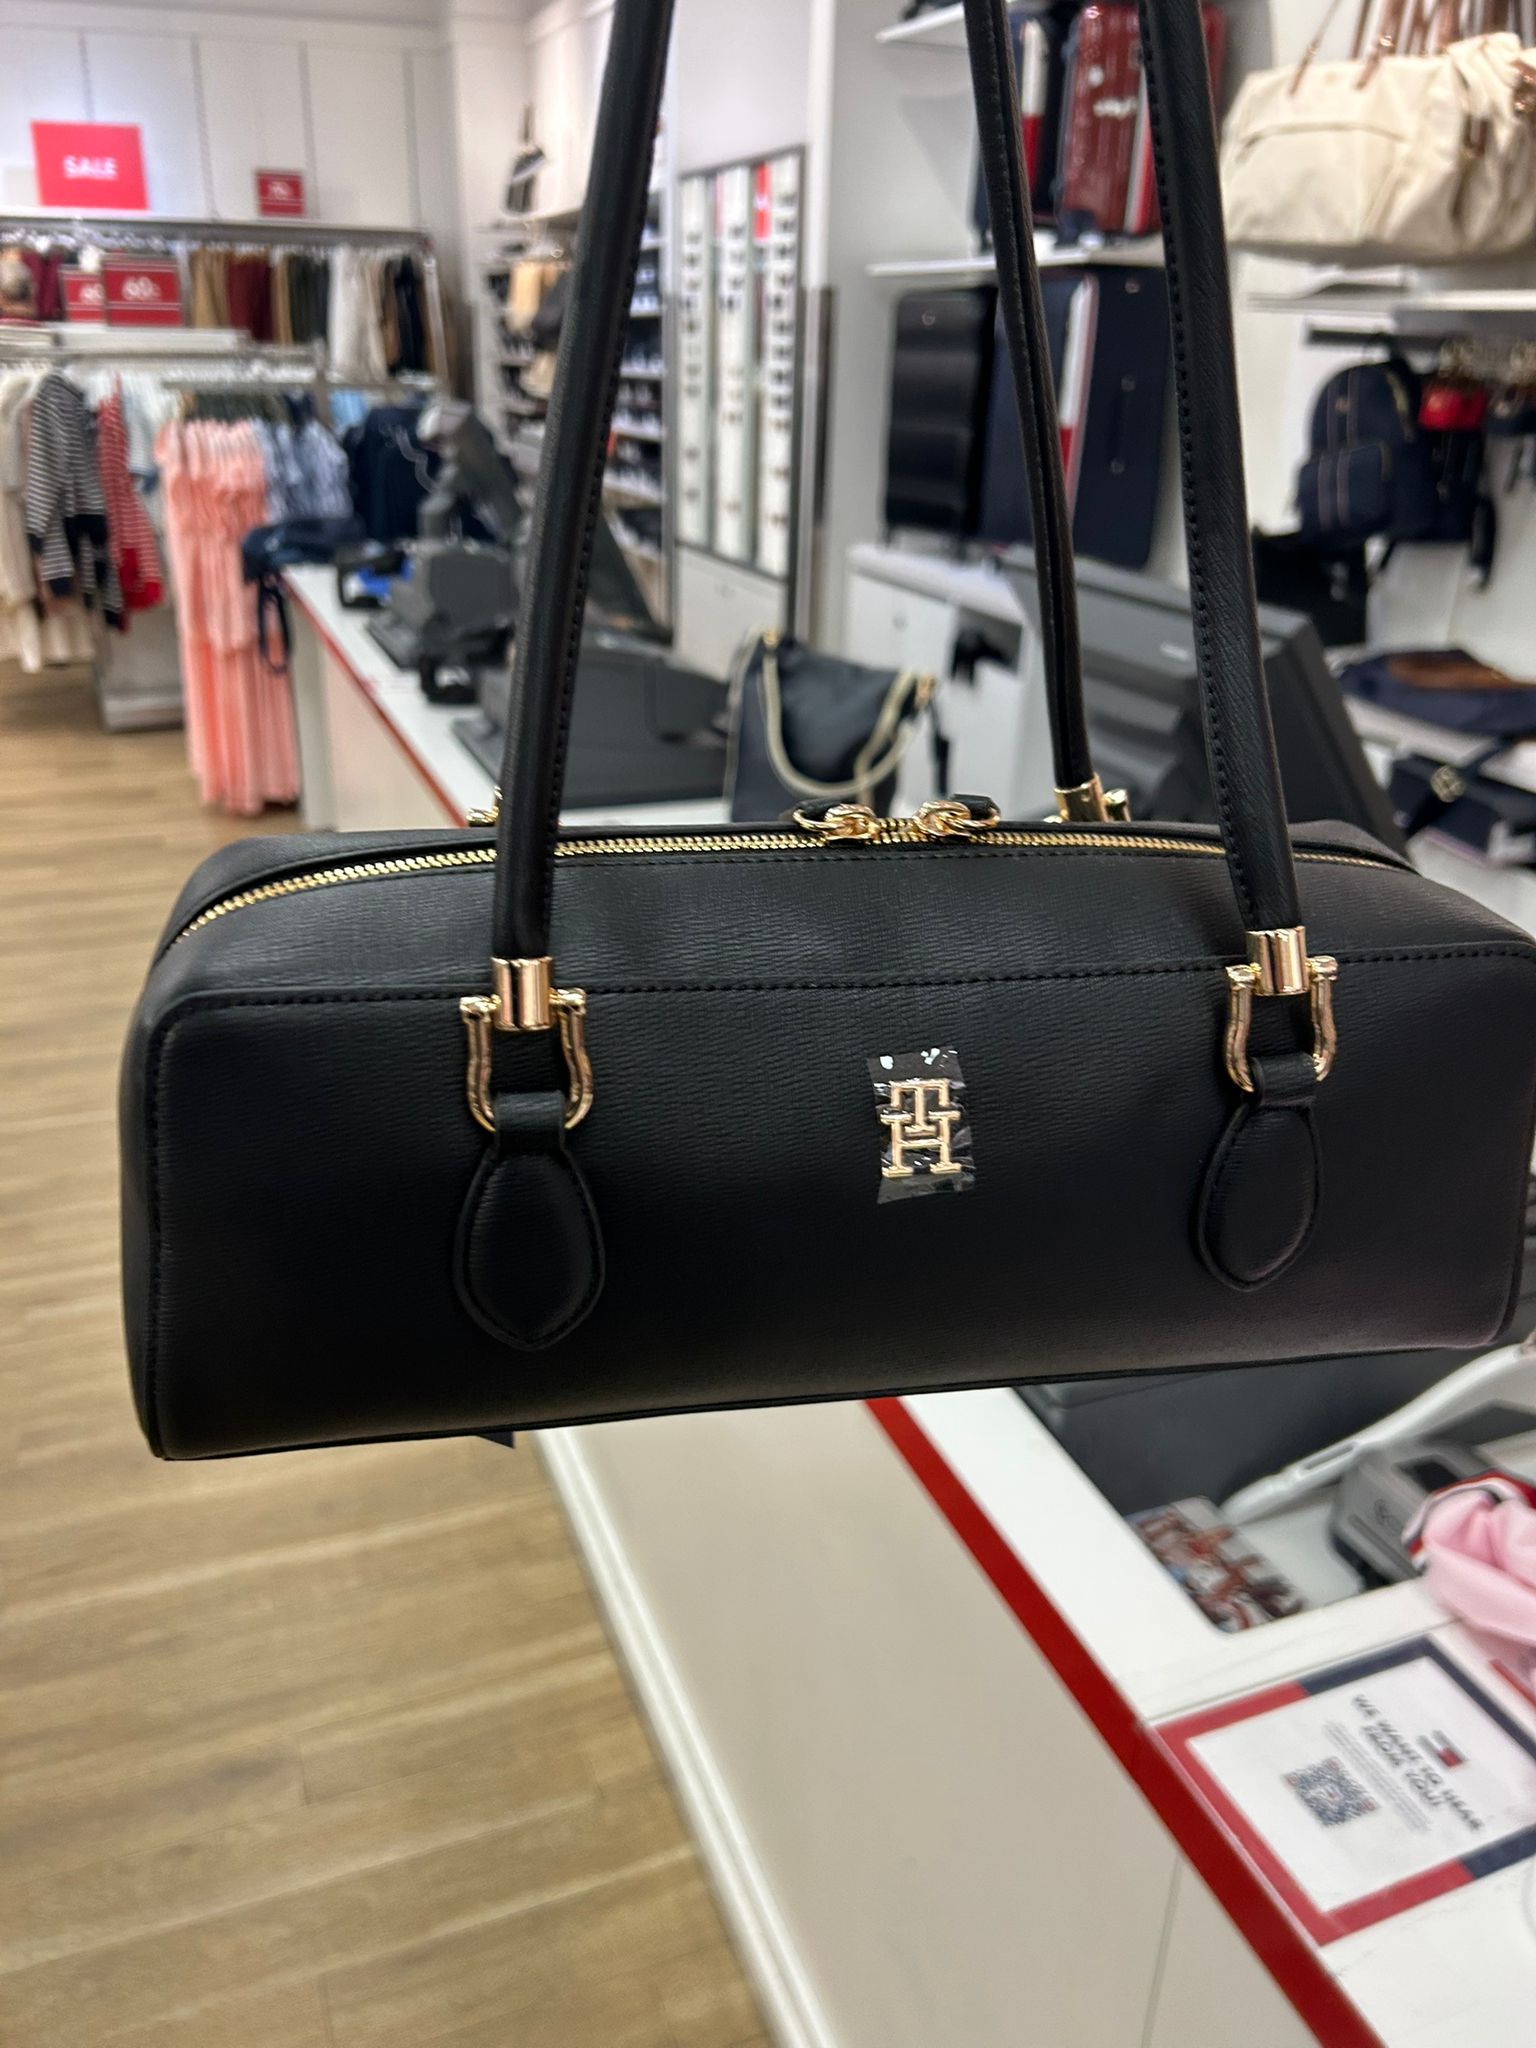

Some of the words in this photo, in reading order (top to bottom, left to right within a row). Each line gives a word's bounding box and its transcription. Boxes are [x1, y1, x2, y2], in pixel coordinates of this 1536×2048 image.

[63, 155, 118, 180] SALE
[1354, 1694, 1380, 1718] WE
[1376, 1719, 1423, 1763] WANT
[1420, 1766, 1444, 1785] TO
[1441, 1788, 1485, 1831] HEAR
[1361, 1725, 1404, 1767] FROM
